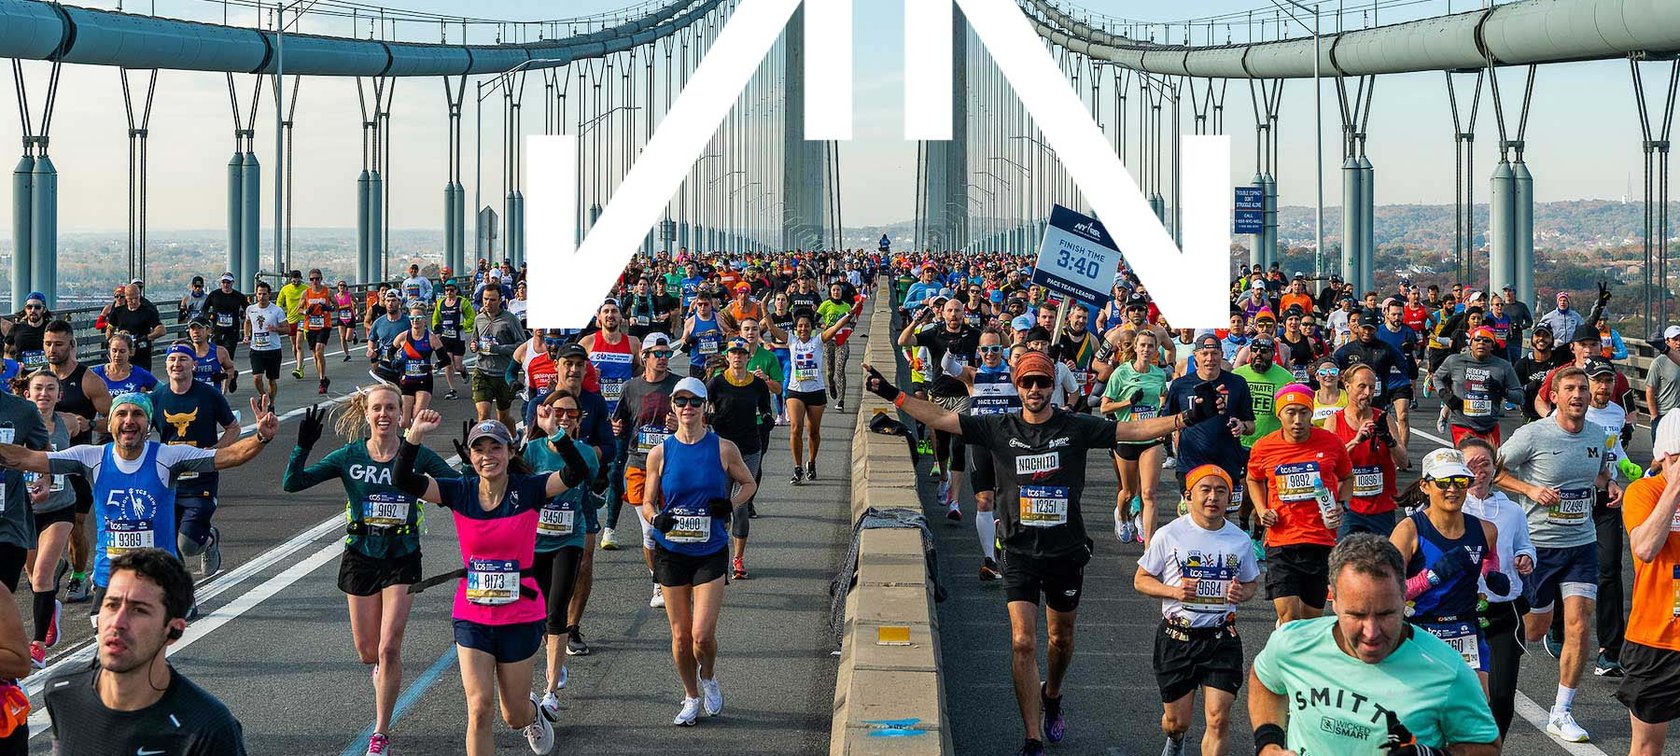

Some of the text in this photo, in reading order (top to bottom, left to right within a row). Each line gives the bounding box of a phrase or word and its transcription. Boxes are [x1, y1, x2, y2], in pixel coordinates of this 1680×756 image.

[1060, 239, 1106, 262] FINISH TIME
[1056, 249, 1100, 280] 3:40
[1046, 278, 1060, 288] PACE
[1061, 282, 1075, 293] TEAM
[1076, 288, 1096, 300] LEADER
[1250, 384, 1272, 392] ONATE
[1254, 398, 1270, 410] FE
[1587, 447, 1599, 458] M
[1020, 455, 1056, 472] NACHITO
[1290, 474, 1310, 487] 9892
[1358, 475, 1378, 486] 10896
[1028, 488, 1039, 497] tcs
[379, 504, 397, 517] 9192
[1036, 500, 1057, 513] 12351
[1563, 500, 1584, 512] 12499
[543, 510, 563, 524] 9450
[680, 518, 700, 530] 9400
[119, 533, 142, 546] 9389
[474, 562, 485, 570] tcs
[1190, 569, 1202, 577] tcs
[484, 574, 504, 589] 8173
[1198, 581, 1221, 596] 9684
[1335, 727, 1369, 740] SMART
[1336, 720, 1371, 734] WICKED
